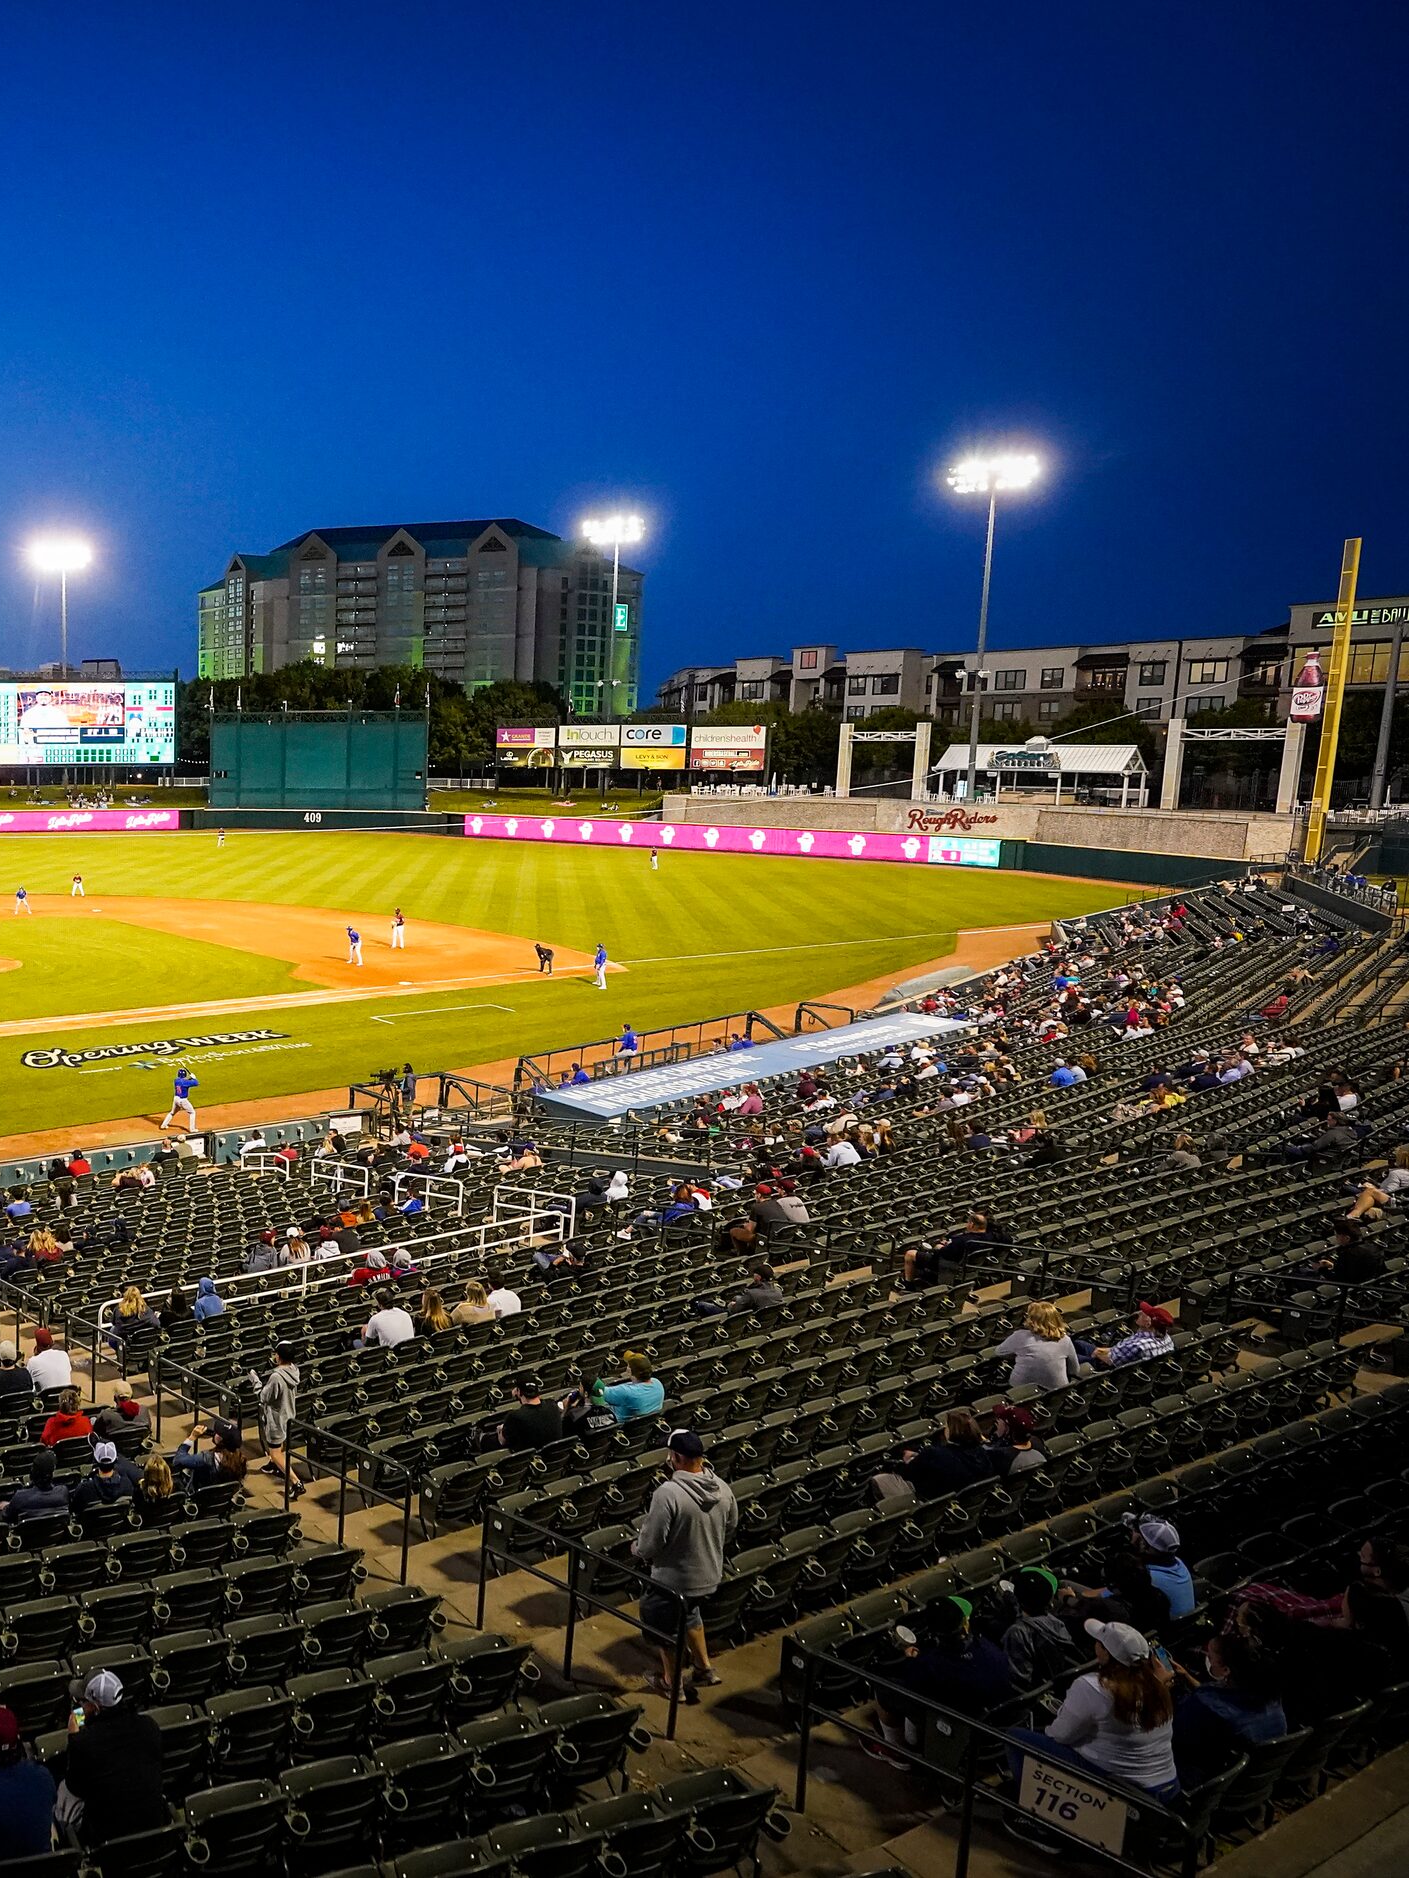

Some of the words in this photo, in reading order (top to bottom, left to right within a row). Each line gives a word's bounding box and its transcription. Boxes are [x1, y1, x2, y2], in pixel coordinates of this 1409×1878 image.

[616, 608, 625, 627] E
[626, 728, 662, 740] core
[574, 750, 614, 758] PEGASUS
[304, 812, 322, 822] 409
[22, 1038, 181, 1068] Opening
[176, 1028, 289, 1048] WEEK
[1032, 1770, 1106, 1811] SECTION
[1035, 1787, 1078, 1821] 116
